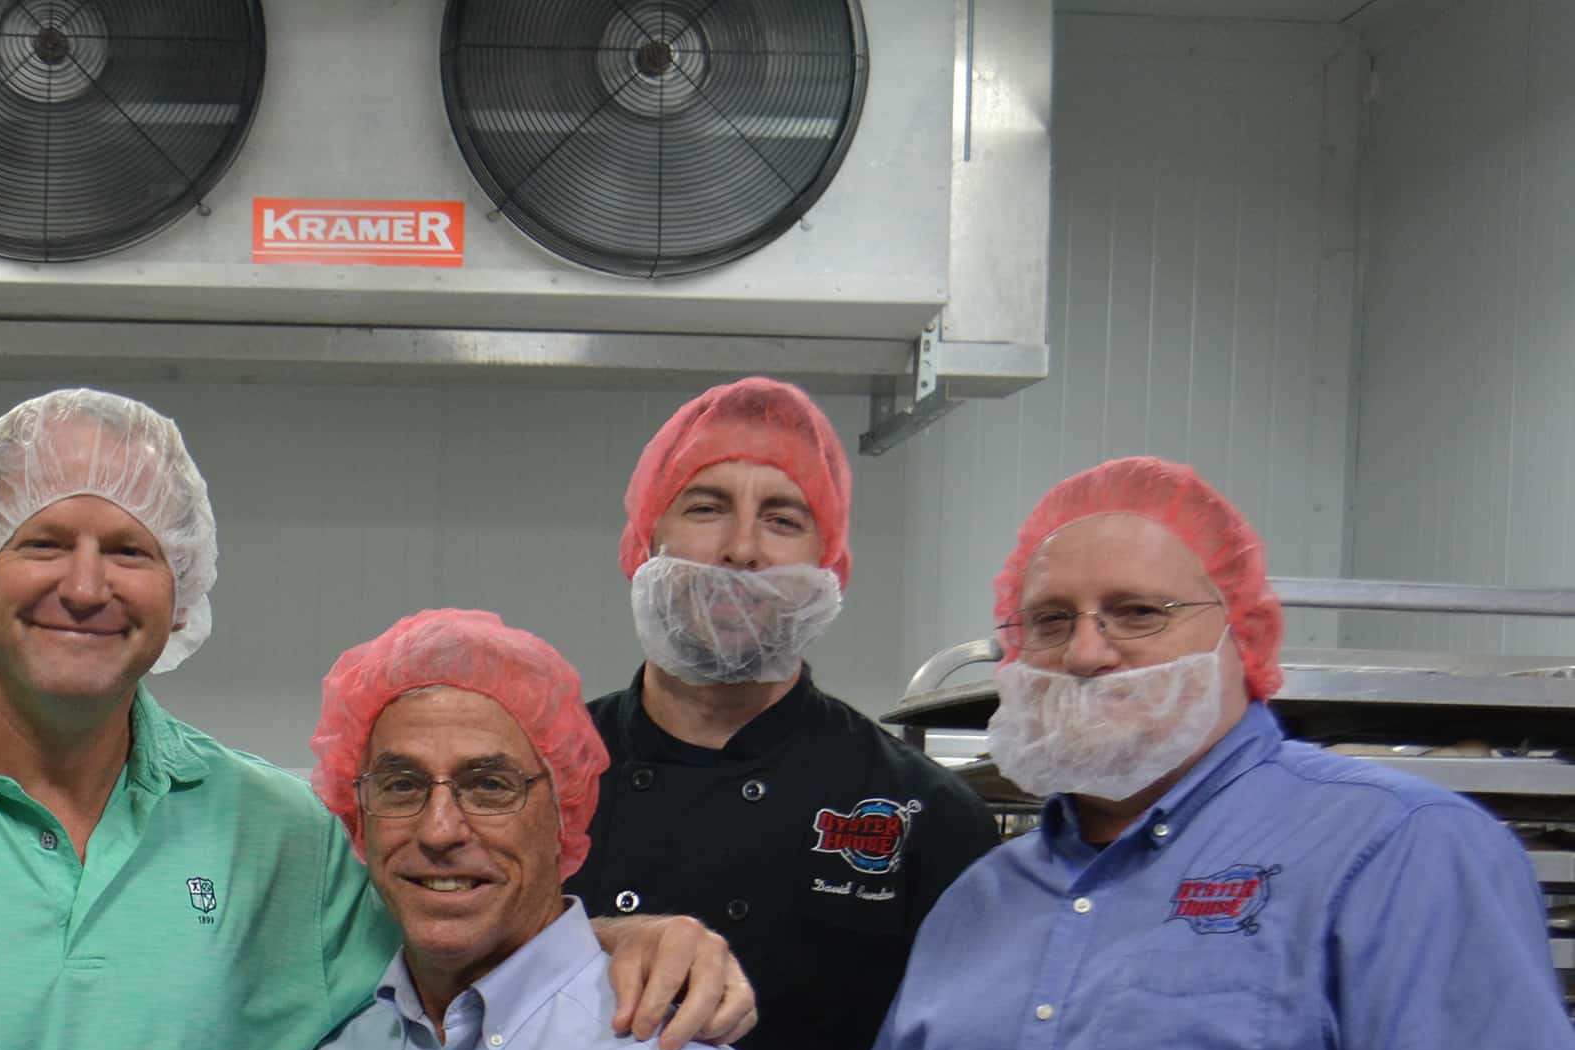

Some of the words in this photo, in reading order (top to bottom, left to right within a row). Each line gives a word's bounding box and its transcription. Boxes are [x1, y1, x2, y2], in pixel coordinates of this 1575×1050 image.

[263, 208, 455, 250] KRAMER
[818, 811, 902, 836] OYSTER
[823, 831, 894, 856] HOUSE
